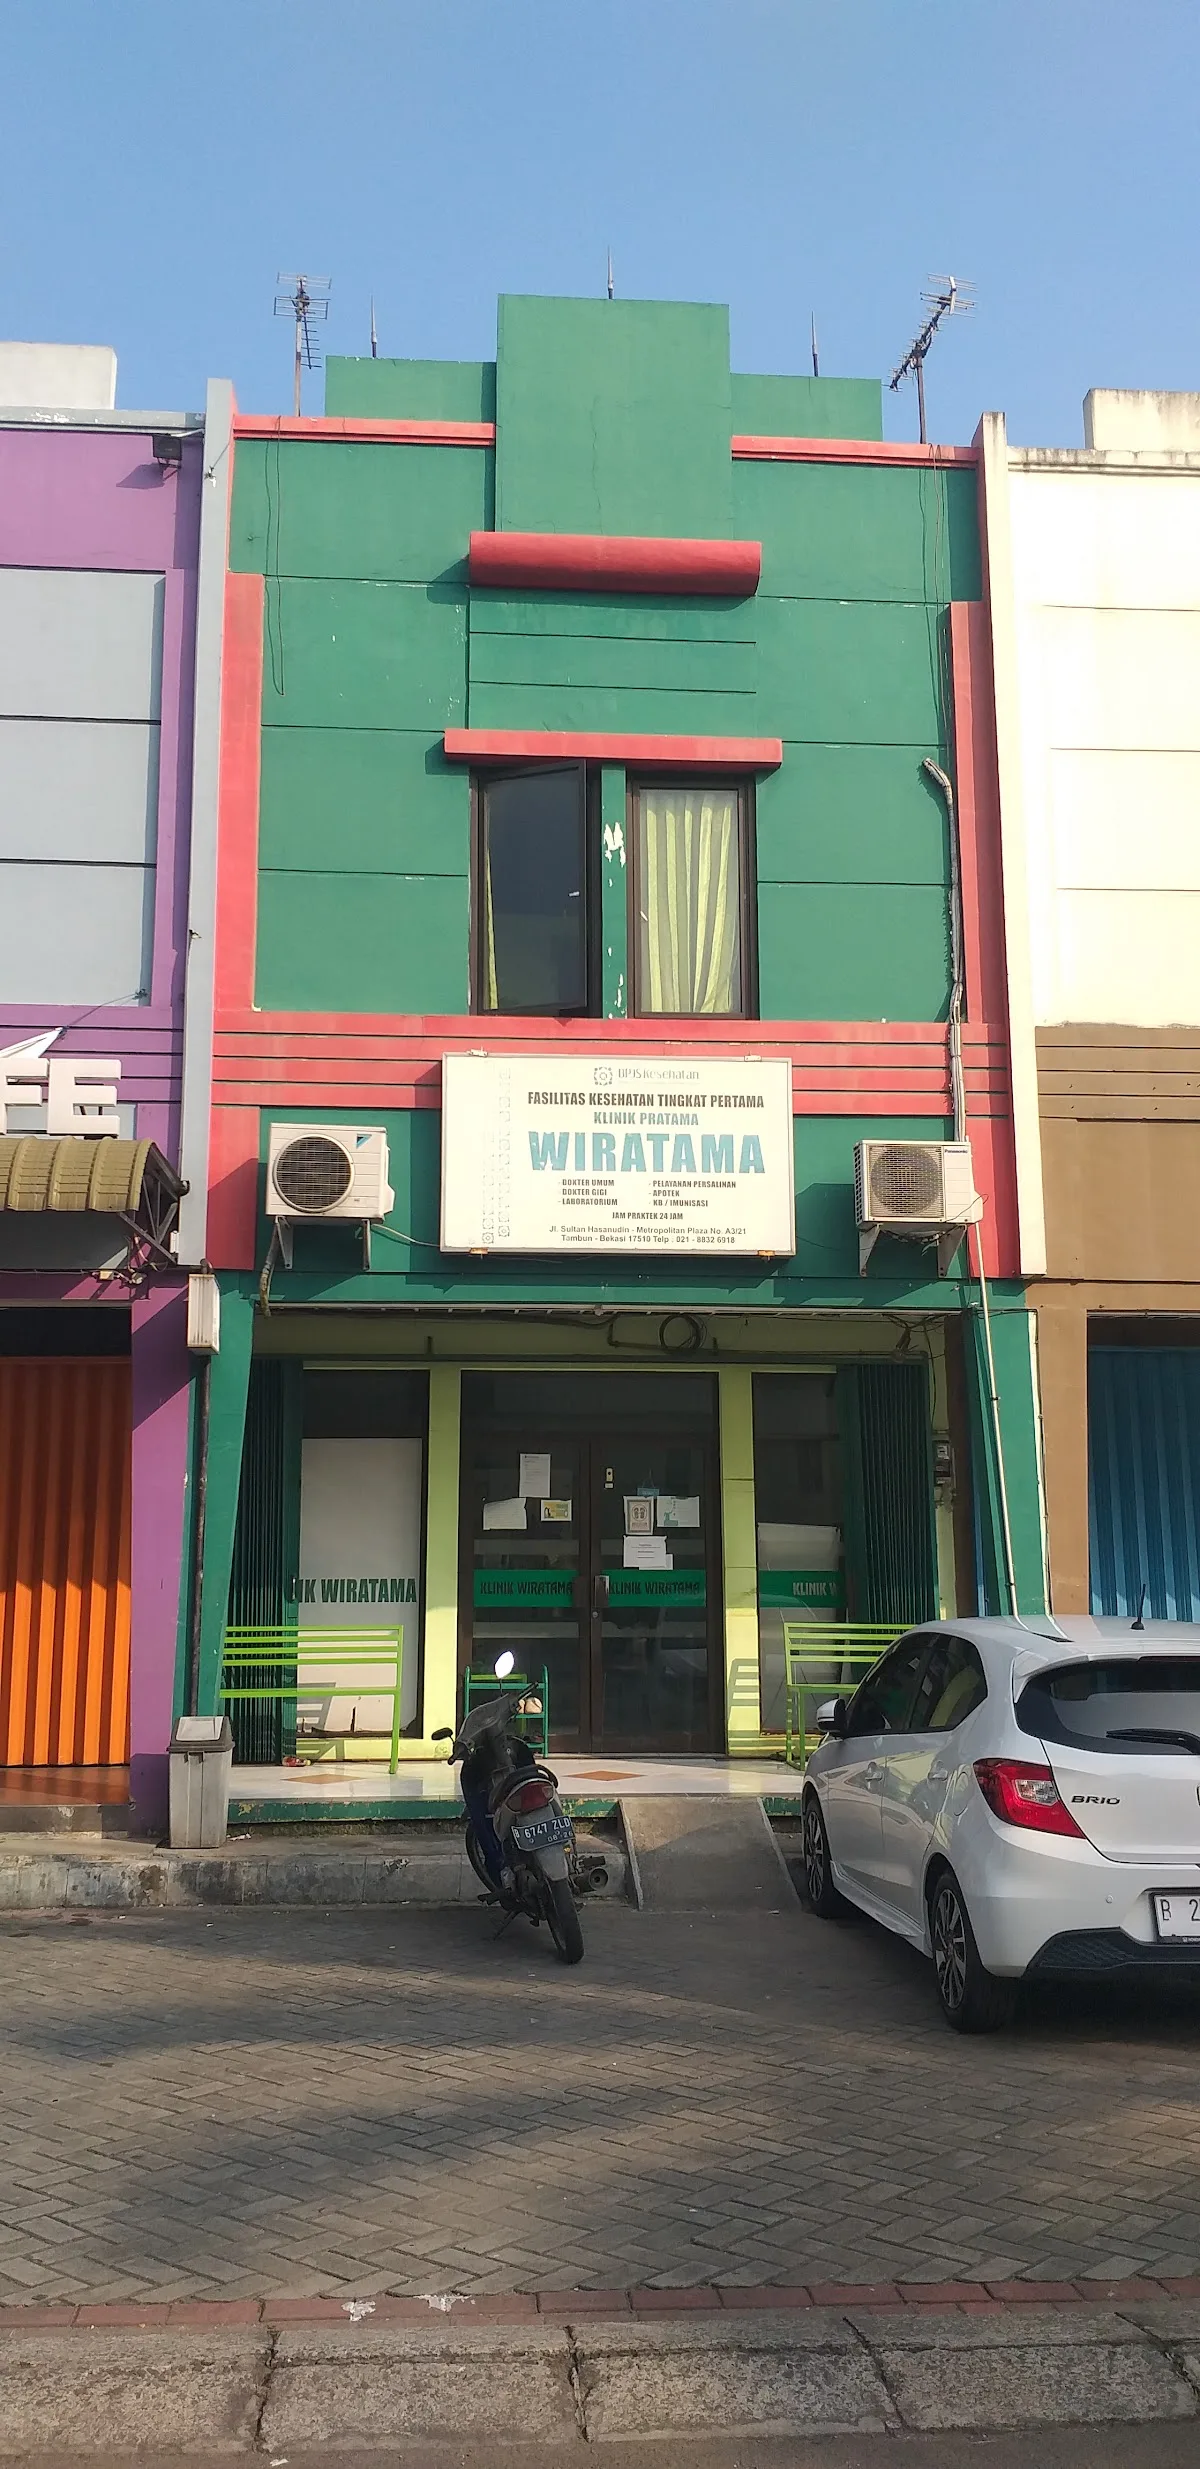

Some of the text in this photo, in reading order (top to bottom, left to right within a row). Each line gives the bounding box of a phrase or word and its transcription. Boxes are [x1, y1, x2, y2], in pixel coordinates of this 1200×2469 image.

[643, 1069, 700, 1080] Kesehatan
[528, 1092, 764, 1108] FASILITAS KESEHATAN TINGKAT PERTAMA
[594, 1112, 698, 1126] KLINIK PRATAMA
[528, 1131, 765, 1174] WIRATAMA
[320, 1578, 416, 1602] WIRATAMA
[480, 1581, 572, 1595] KLINIK WIRATAMA
[609, 1582, 700, 1596] KLINIK WIRATAMA
[792, 1582, 827, 1596] KLINIK
[1071, 1796, 1120, 1805] BRIO
[514, 1818, 570, 1838] B 6747 ZLD
[1160, 1898, 1200, 1921] B 2
